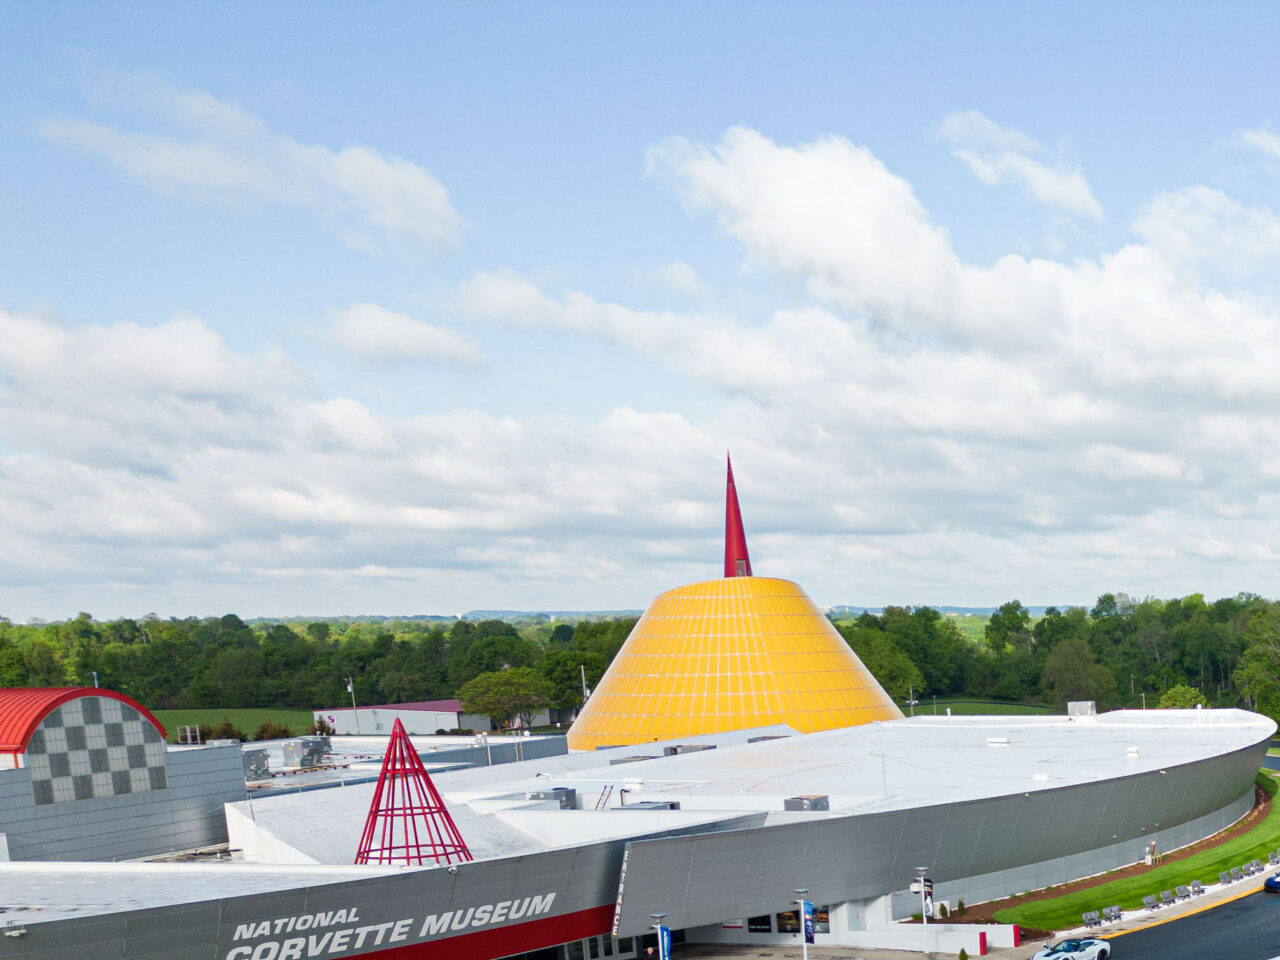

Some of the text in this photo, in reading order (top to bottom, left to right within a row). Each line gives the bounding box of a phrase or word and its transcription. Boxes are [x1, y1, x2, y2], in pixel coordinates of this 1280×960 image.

[419, 892, 556, 937] MUSEUM
[613, 850, 629, 935] ENTRANCE
[233, 908, 359, 941] NATIONAL
